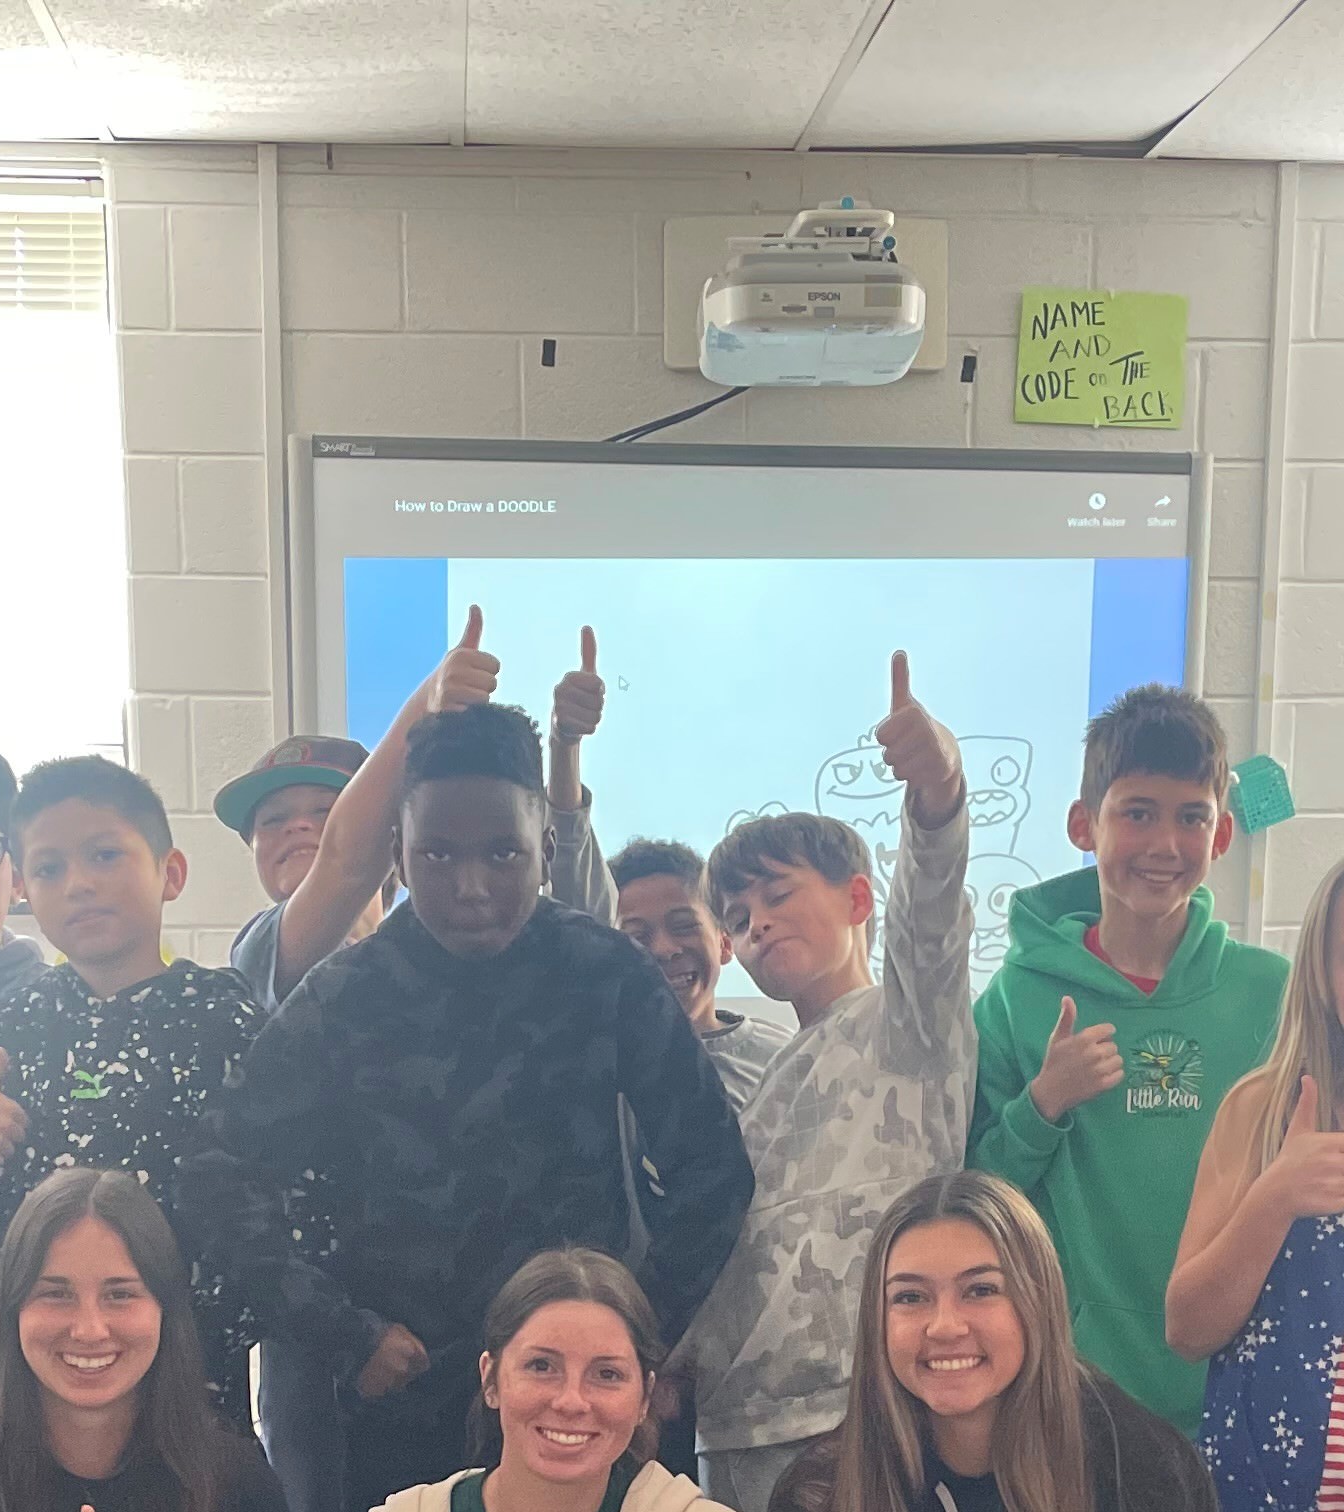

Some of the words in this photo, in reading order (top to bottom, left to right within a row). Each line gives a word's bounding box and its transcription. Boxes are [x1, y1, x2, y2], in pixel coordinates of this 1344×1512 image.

[808, 292, 841, 301] EPSON
[1032, 301, 1105, 340] NAME
[1049, 334, 1111, 362] AND
[1021, 368, 1080, 404] CODE
[1089, 372, 1106, 386] on
[1109, 351, 1152, 385] THE
[1103, 390, 1173, 419] BACK
[394, 500, 427, 512] How
[430, 500, 444, 512] to
[447, 500, 483, 512] Draw
[486, 503, 495, 512] a
[498, 500, 556, 513] DOODLE
[1127, 1086, 1164, 1113] Little
[1167, 1087, 1202, 1111] Run
